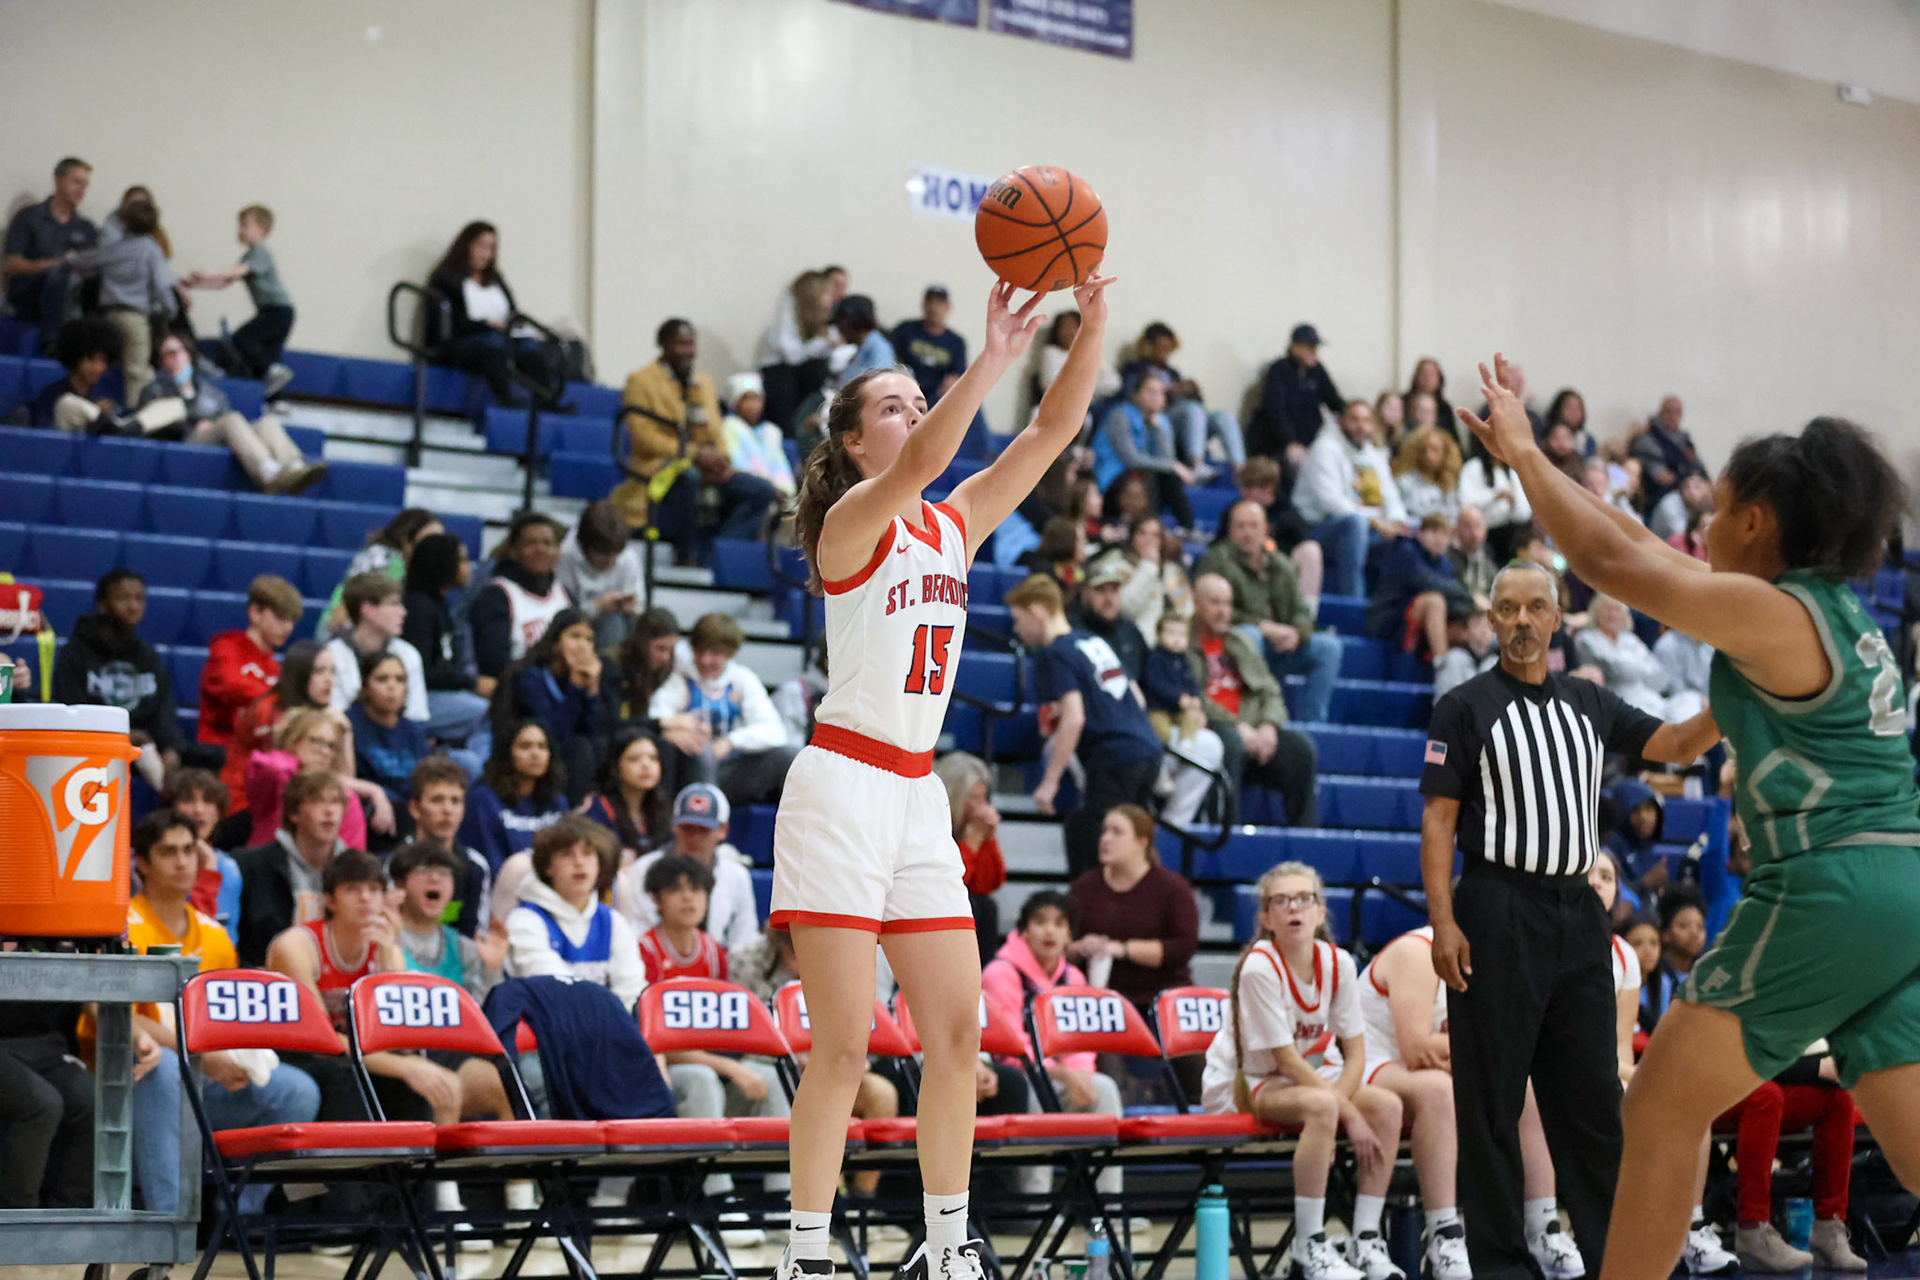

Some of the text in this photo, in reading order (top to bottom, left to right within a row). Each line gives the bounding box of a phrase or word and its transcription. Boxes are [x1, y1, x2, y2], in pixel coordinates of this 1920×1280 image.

[886, 579, 915, 615] ST.
[904, 624, 954, 695] 15
[64, 766, 109, 825] G
[205, 980, 300, 1023] SBA
[373, 984, 461, 1027] SBA
[662, 990, 749, 1030] SBA
[1051, 996, 1126, 1032] SBA
